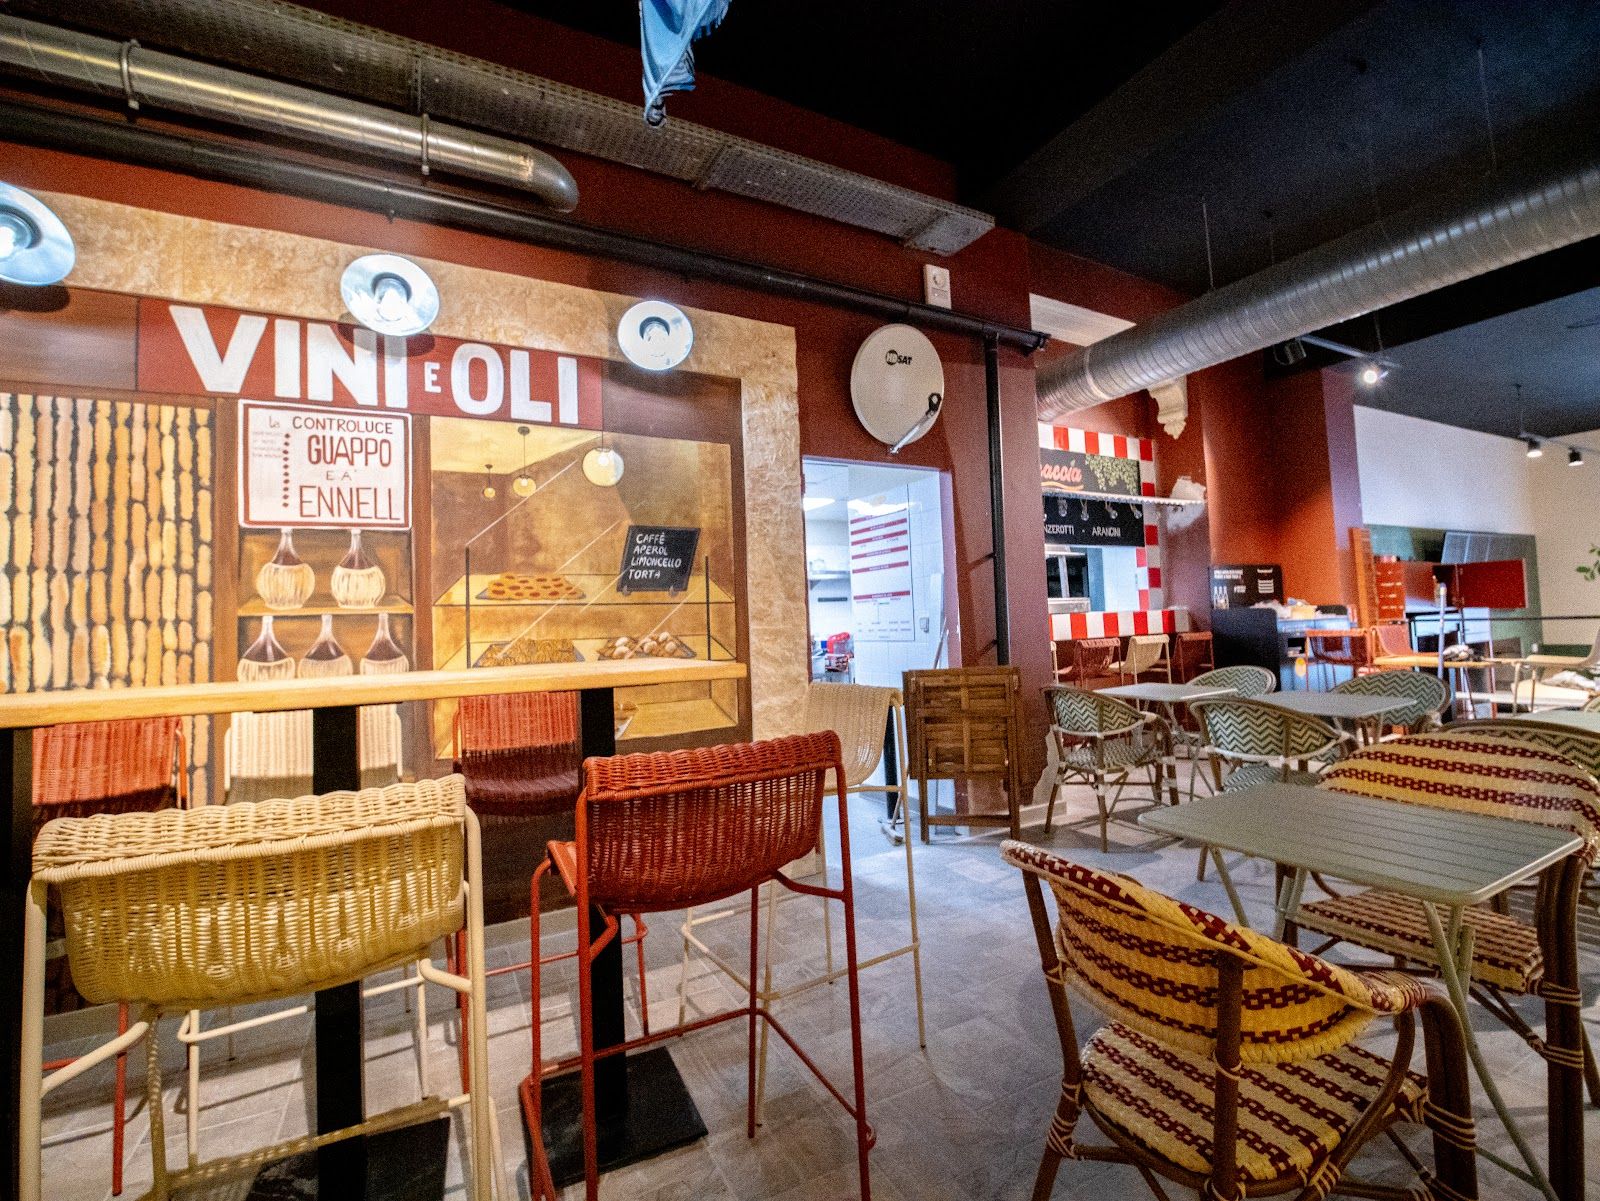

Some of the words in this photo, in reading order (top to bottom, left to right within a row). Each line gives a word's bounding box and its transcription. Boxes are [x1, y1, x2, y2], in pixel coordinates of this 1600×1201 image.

[168, 304, 408, 409] VINI
[424, 361, 442, 393] E
[451, 342, 579, 425] OLI
[292, 415, 394, 435] CONTROLUCE
[307, 434, 392, 468] GUAPPO
[326, 470, 334, 481] E
[300, 485, 401, 521] ENNELL
[1091, 525, 1121, 538] ARANCINI
[633, 545, 668, 556] APEROL
[630, 556, 682, 569] LIMONCELLO
[628, 568, 661, 580] TORTA
